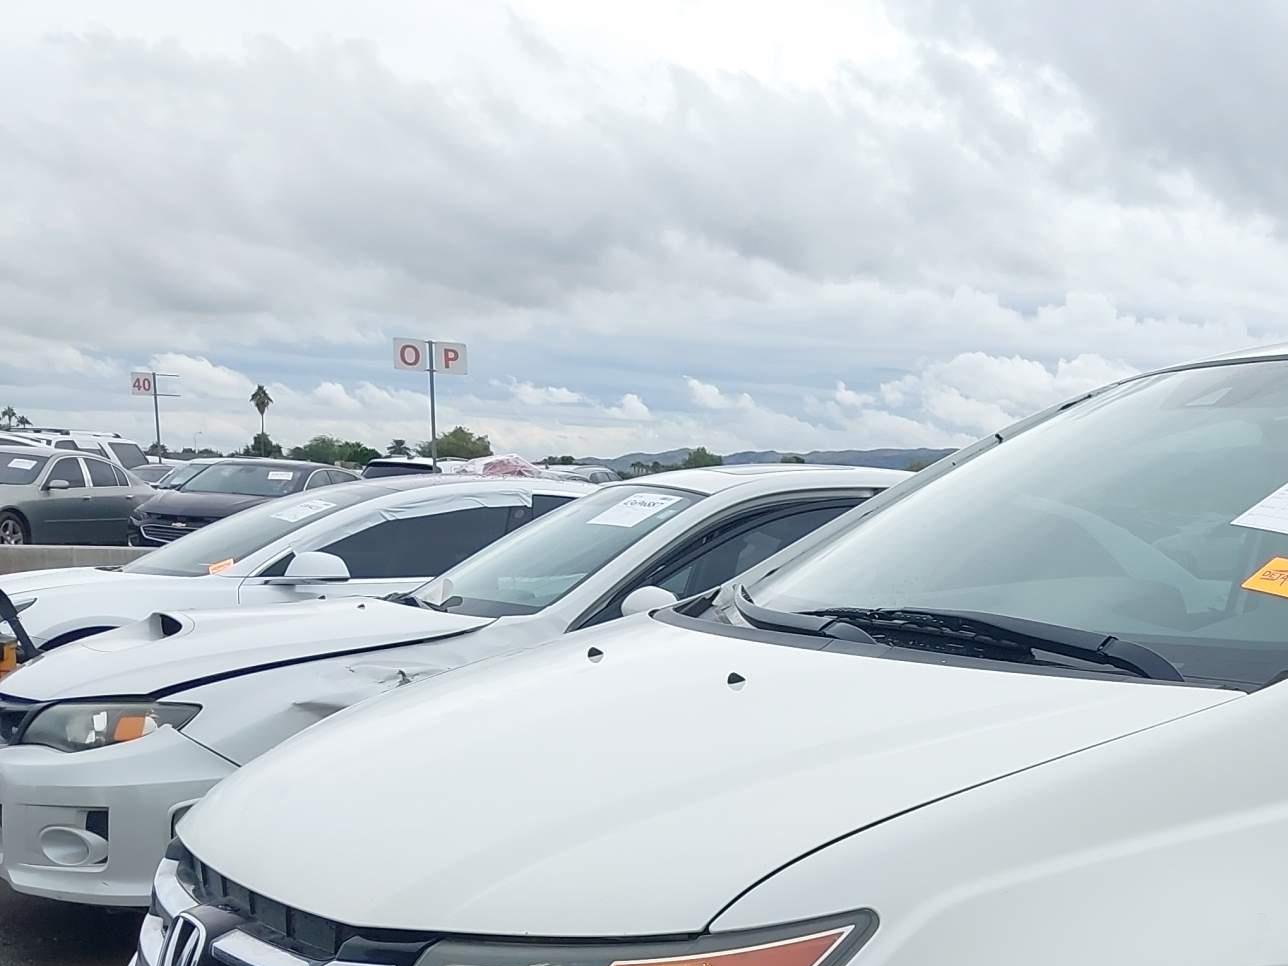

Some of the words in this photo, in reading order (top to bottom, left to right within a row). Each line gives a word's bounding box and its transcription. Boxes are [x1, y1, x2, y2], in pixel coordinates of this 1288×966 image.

[399, 344, 421, 366] O
[444, 348, 460, 369] P
[132, 376, 151, 392] 40
